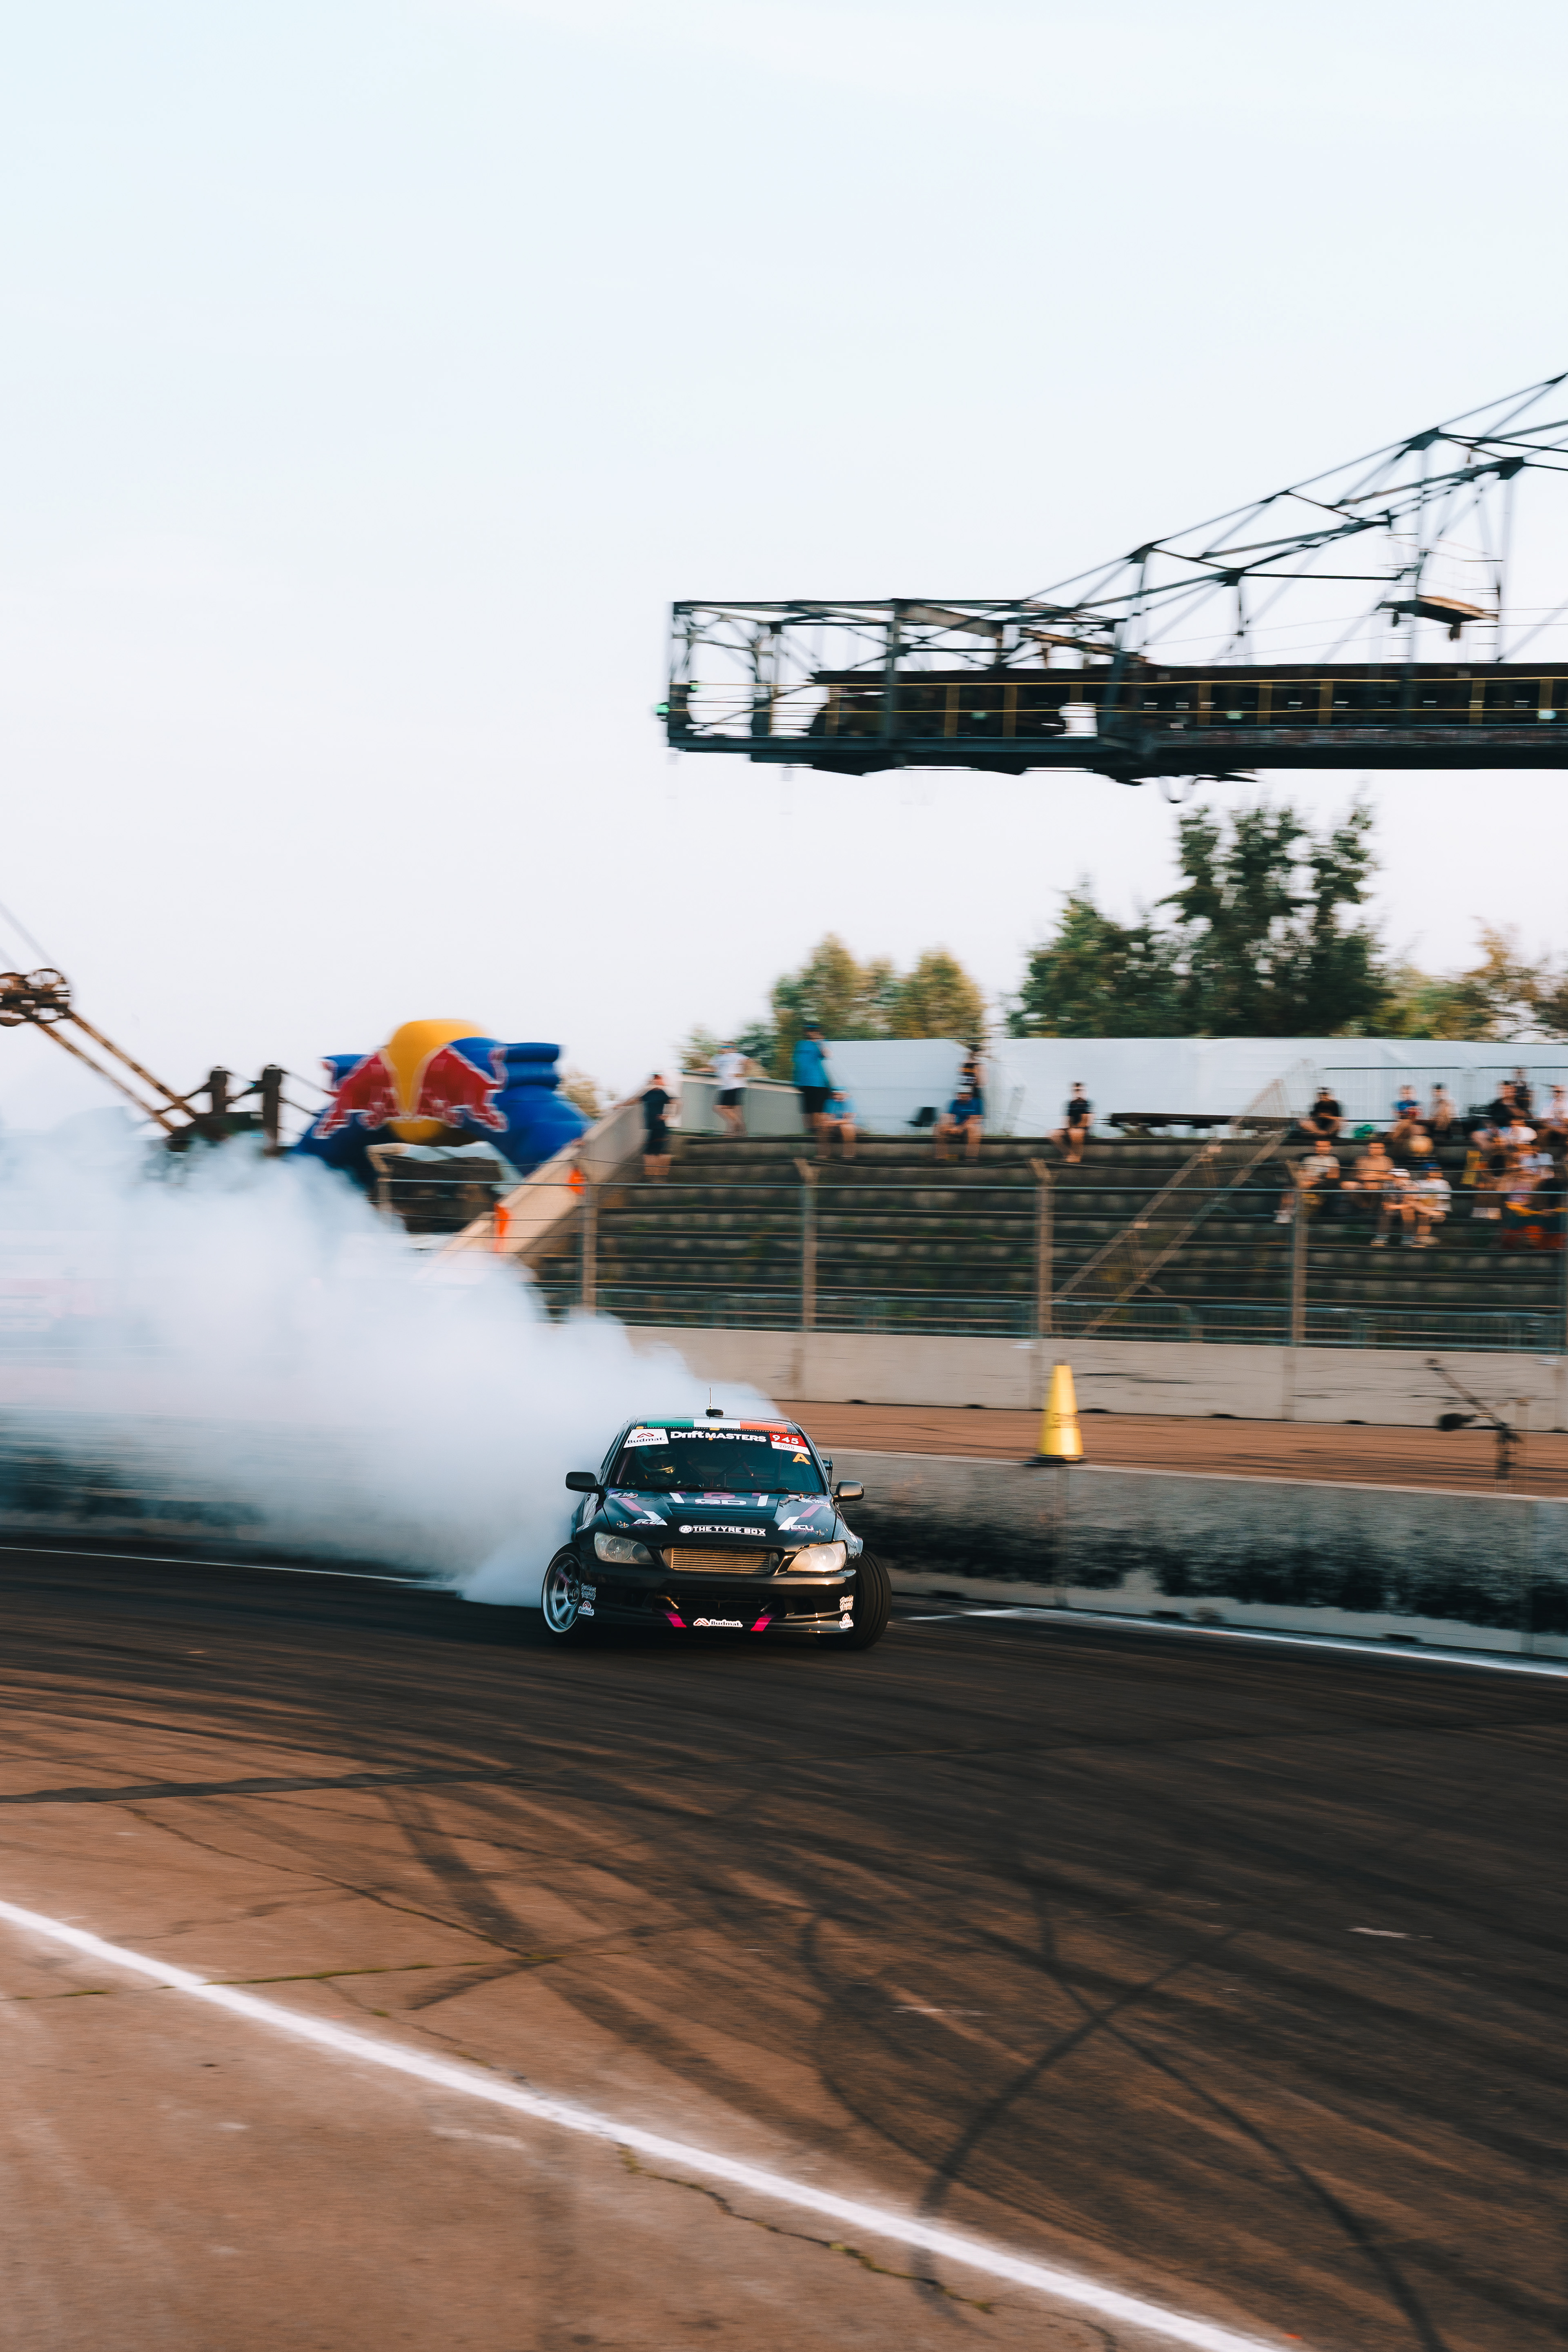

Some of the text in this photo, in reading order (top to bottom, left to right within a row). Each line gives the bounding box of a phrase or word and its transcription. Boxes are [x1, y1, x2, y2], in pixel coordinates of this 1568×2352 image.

[705, 1432, 767, 1442] MASTERS
[772, 1434, 799, 1445] 945
[792, 1453, 811, 1465] A
[744, 1528, 766, 1536] BOX
